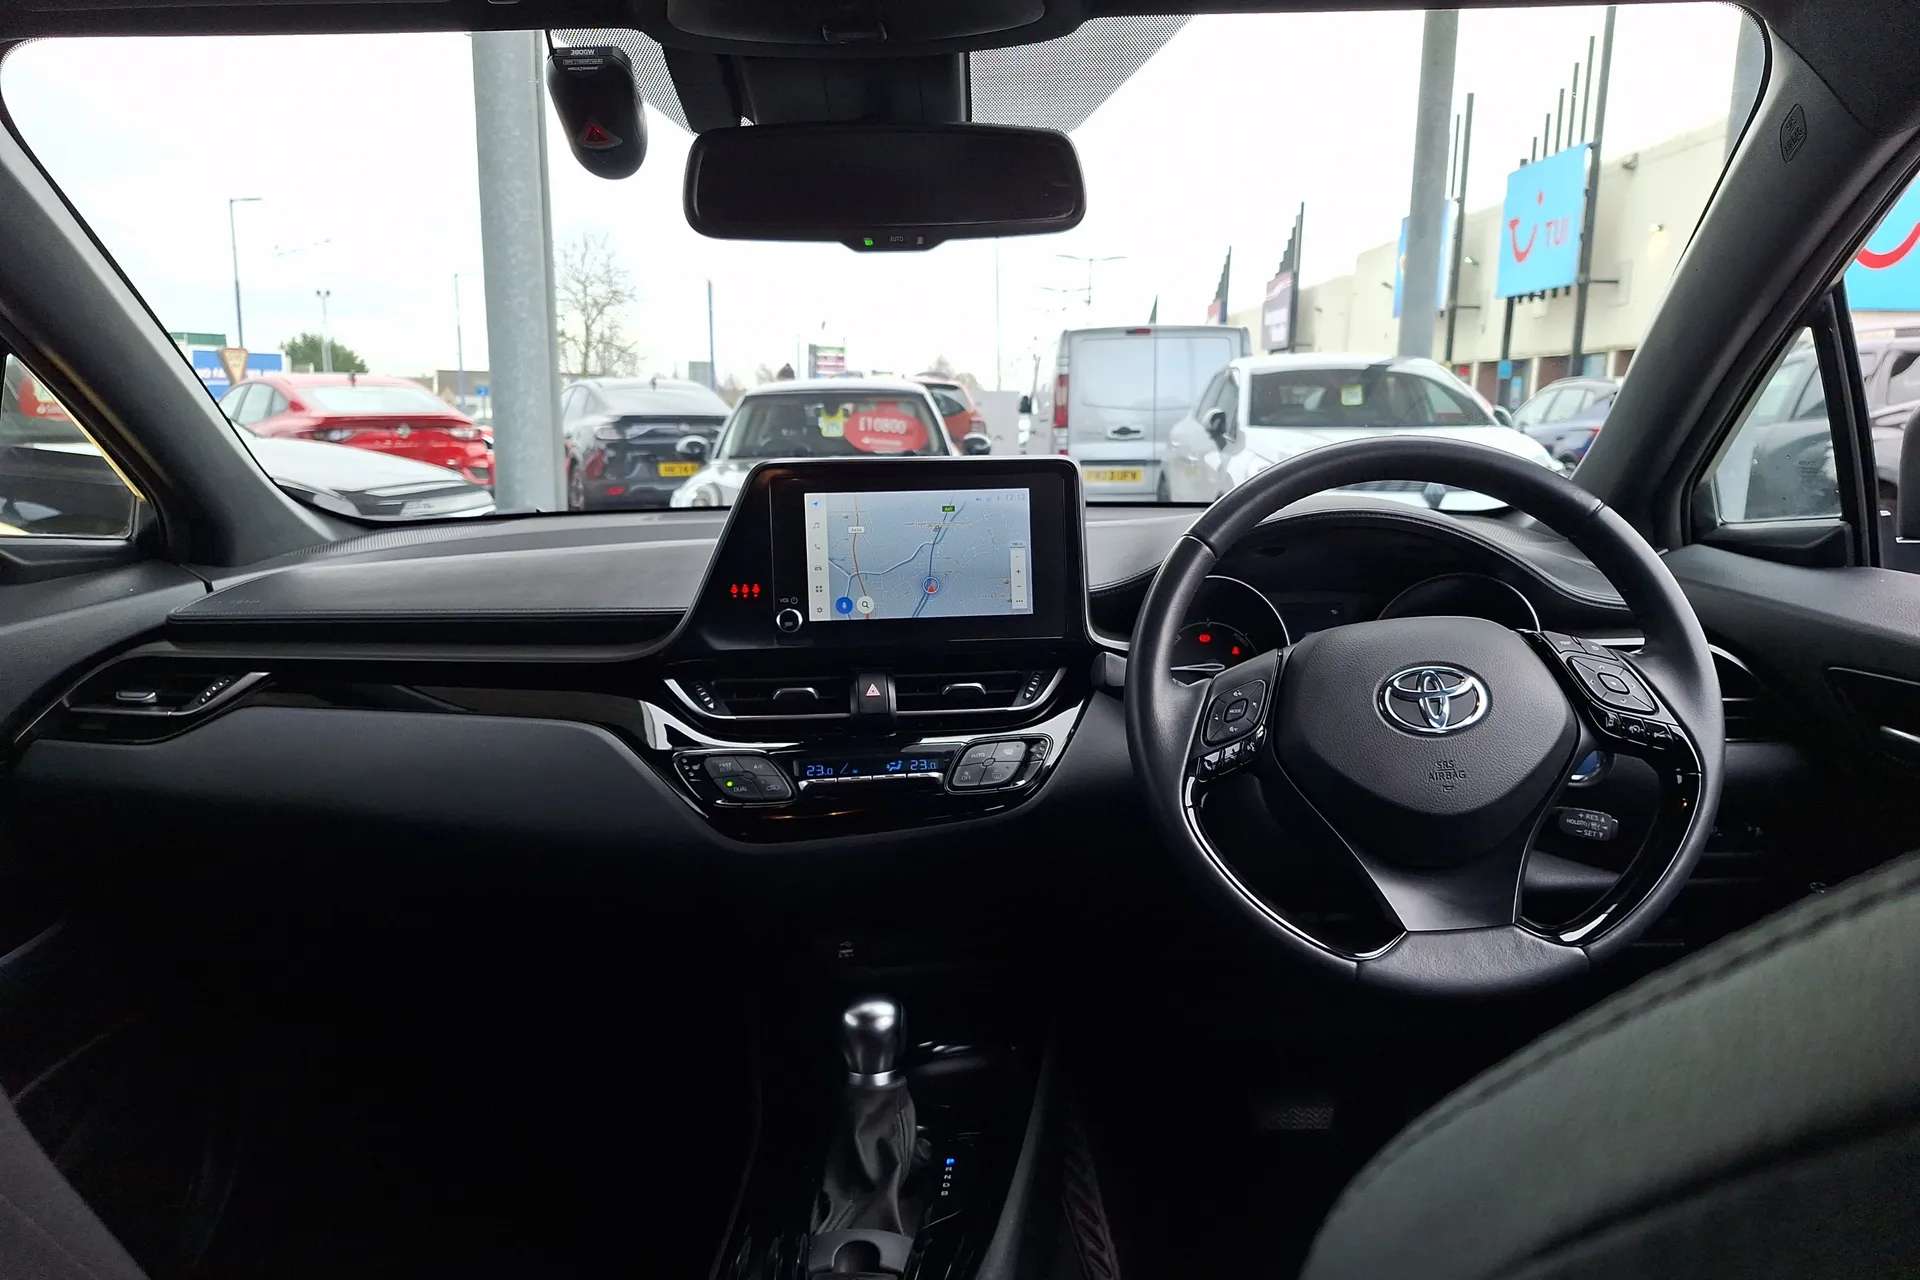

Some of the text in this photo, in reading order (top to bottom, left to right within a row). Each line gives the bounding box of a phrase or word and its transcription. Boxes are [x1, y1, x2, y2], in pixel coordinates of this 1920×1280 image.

[1545, 217, 1569, 248] TUI
[806, 759, 937, 777] 23.0 23.0
[1434, 759, 1455, 769] SRS
[1429, 770, 1466, 781] AIRBAG
